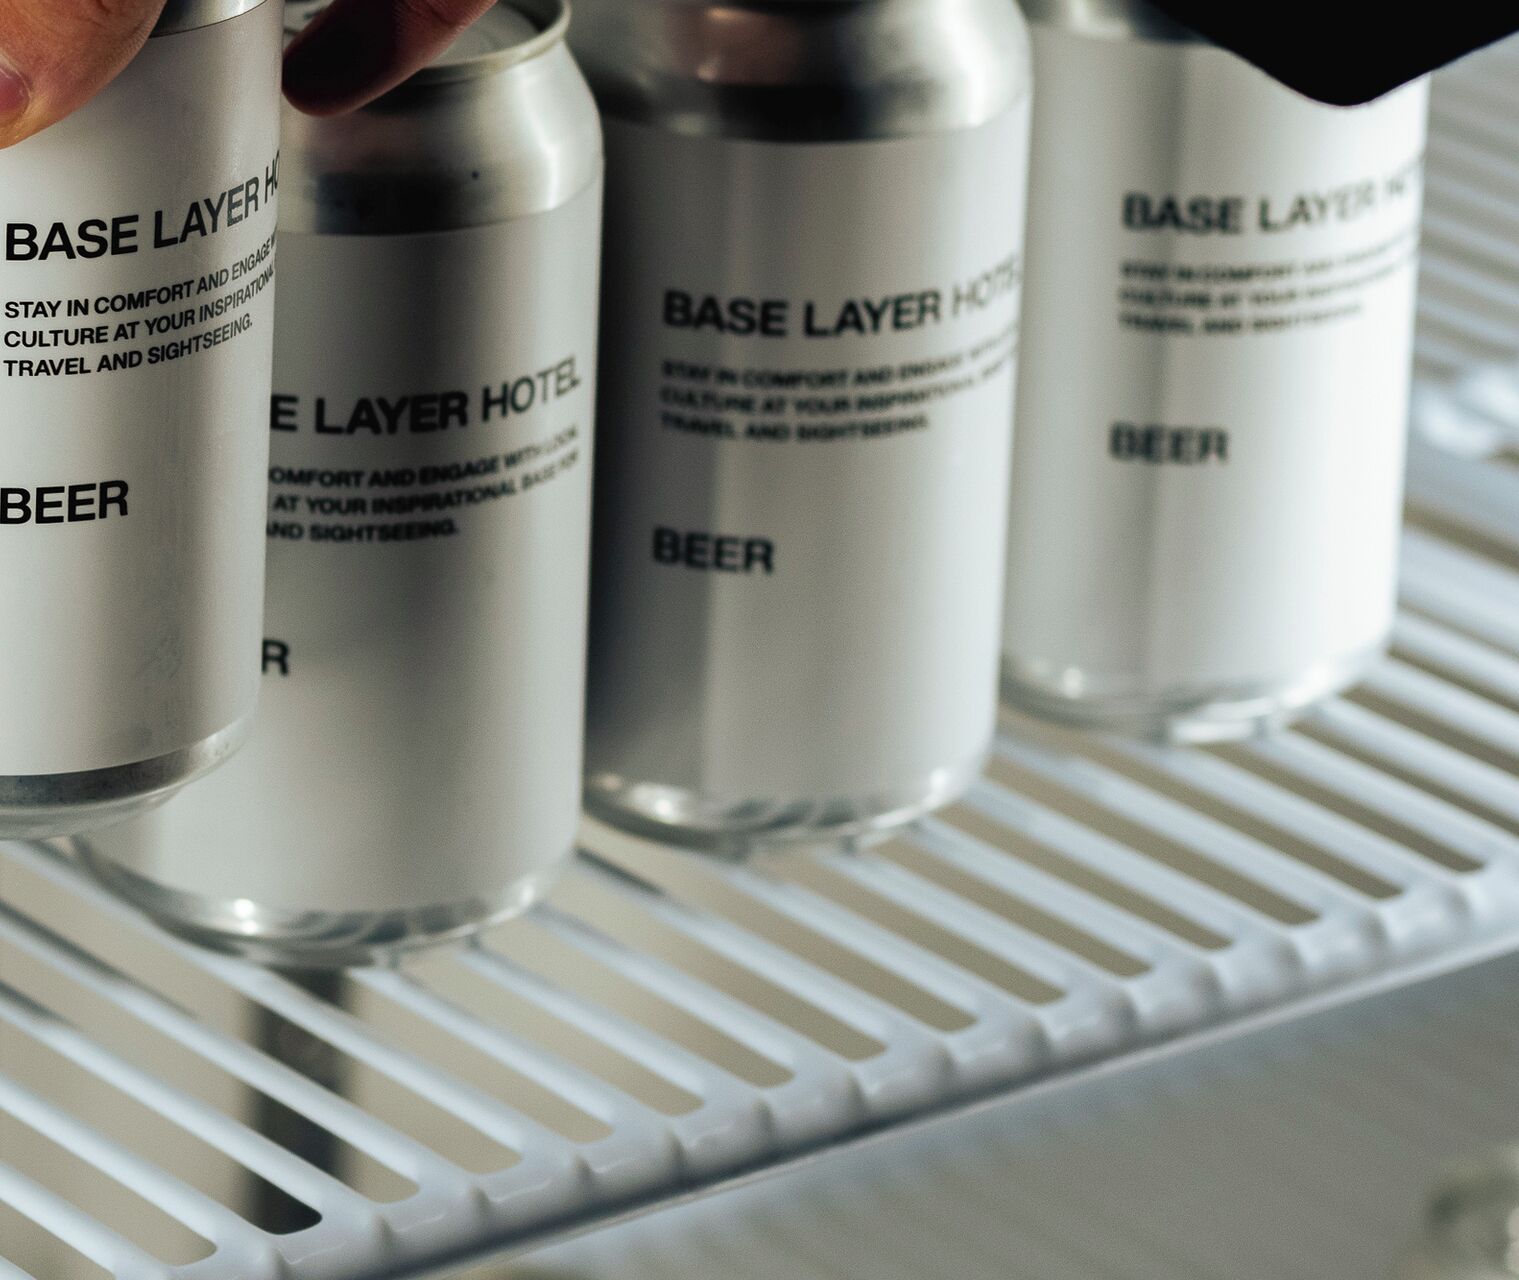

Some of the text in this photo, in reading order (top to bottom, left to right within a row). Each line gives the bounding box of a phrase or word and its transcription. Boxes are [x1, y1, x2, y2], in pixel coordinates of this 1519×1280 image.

[5, 214, 139, 261] BASE
[154, 176, 259, 249] LAYER
[4, 300, 61, 318] STAY
[67, 299, 89, 317] IN
[94, 280, 194, 315] COMFORT
[196, 269, 229, 295] AND
[232, 237, 270, 281] ENGAGE
[4, 326, 108, 347] CULTURE
[114, 321, 139, 340] AT
[145, 309, 195, 335] YOUR
[664, 289, 789, 339] BASE
[803, 288, 941, 339] LAYER
[4, 313, 253, 376] TRAVEL AND SIGHTSEEING.
[314, 391, 469, 436] LAYER
[482, 355, 581, 423] HOTEL
[0, 480, 129, 524] BEER
[269, 466, 364, 488] OMFORT
[652, 525, 775, 575] BEER
